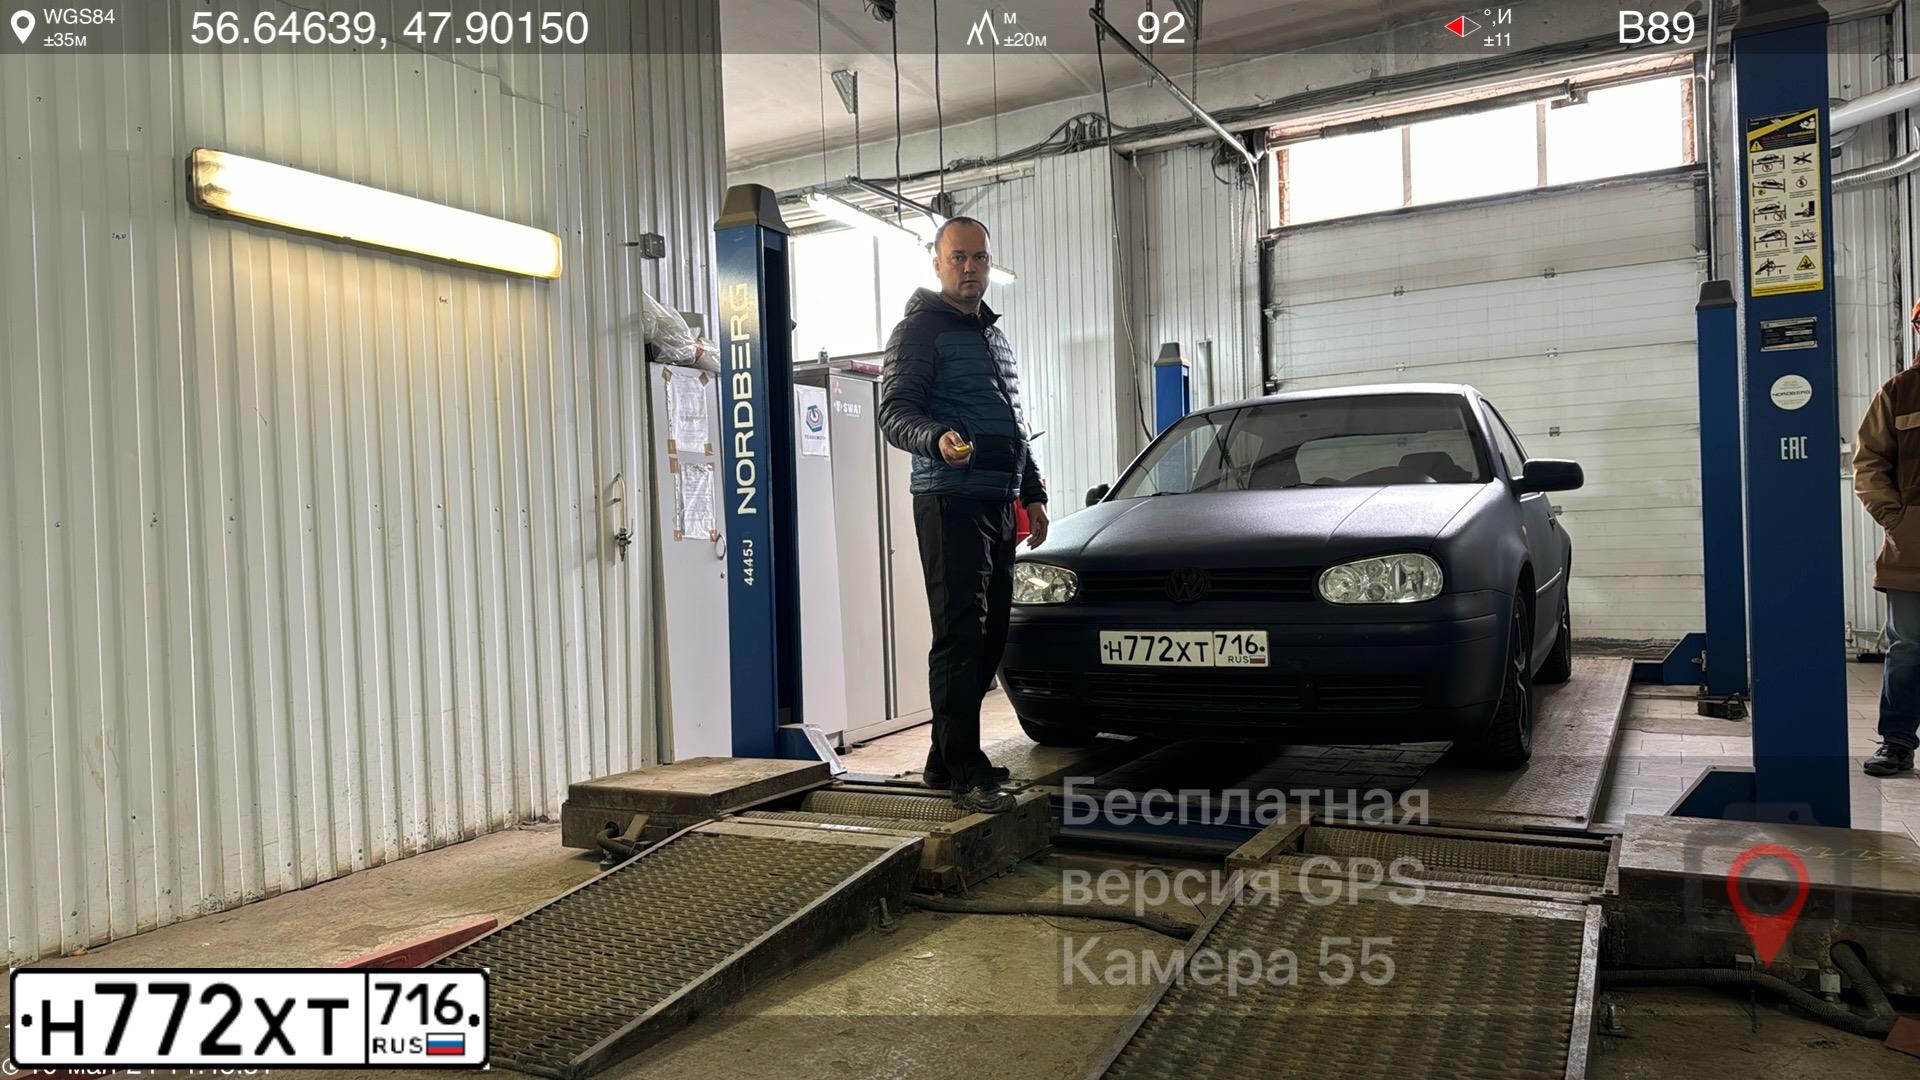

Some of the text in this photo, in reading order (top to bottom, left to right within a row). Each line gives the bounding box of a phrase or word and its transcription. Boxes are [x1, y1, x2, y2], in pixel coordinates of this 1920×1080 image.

[729, 283, 757, 515] NORDBERG
[843, 402, 862, 415] SWAT
[1780, 436, 1809, 460] EAC
[742, 539, 755, 587] 4445J
[1215, 633, 1259, 655] 716
[1227, 655, 1250, 664] RUS
